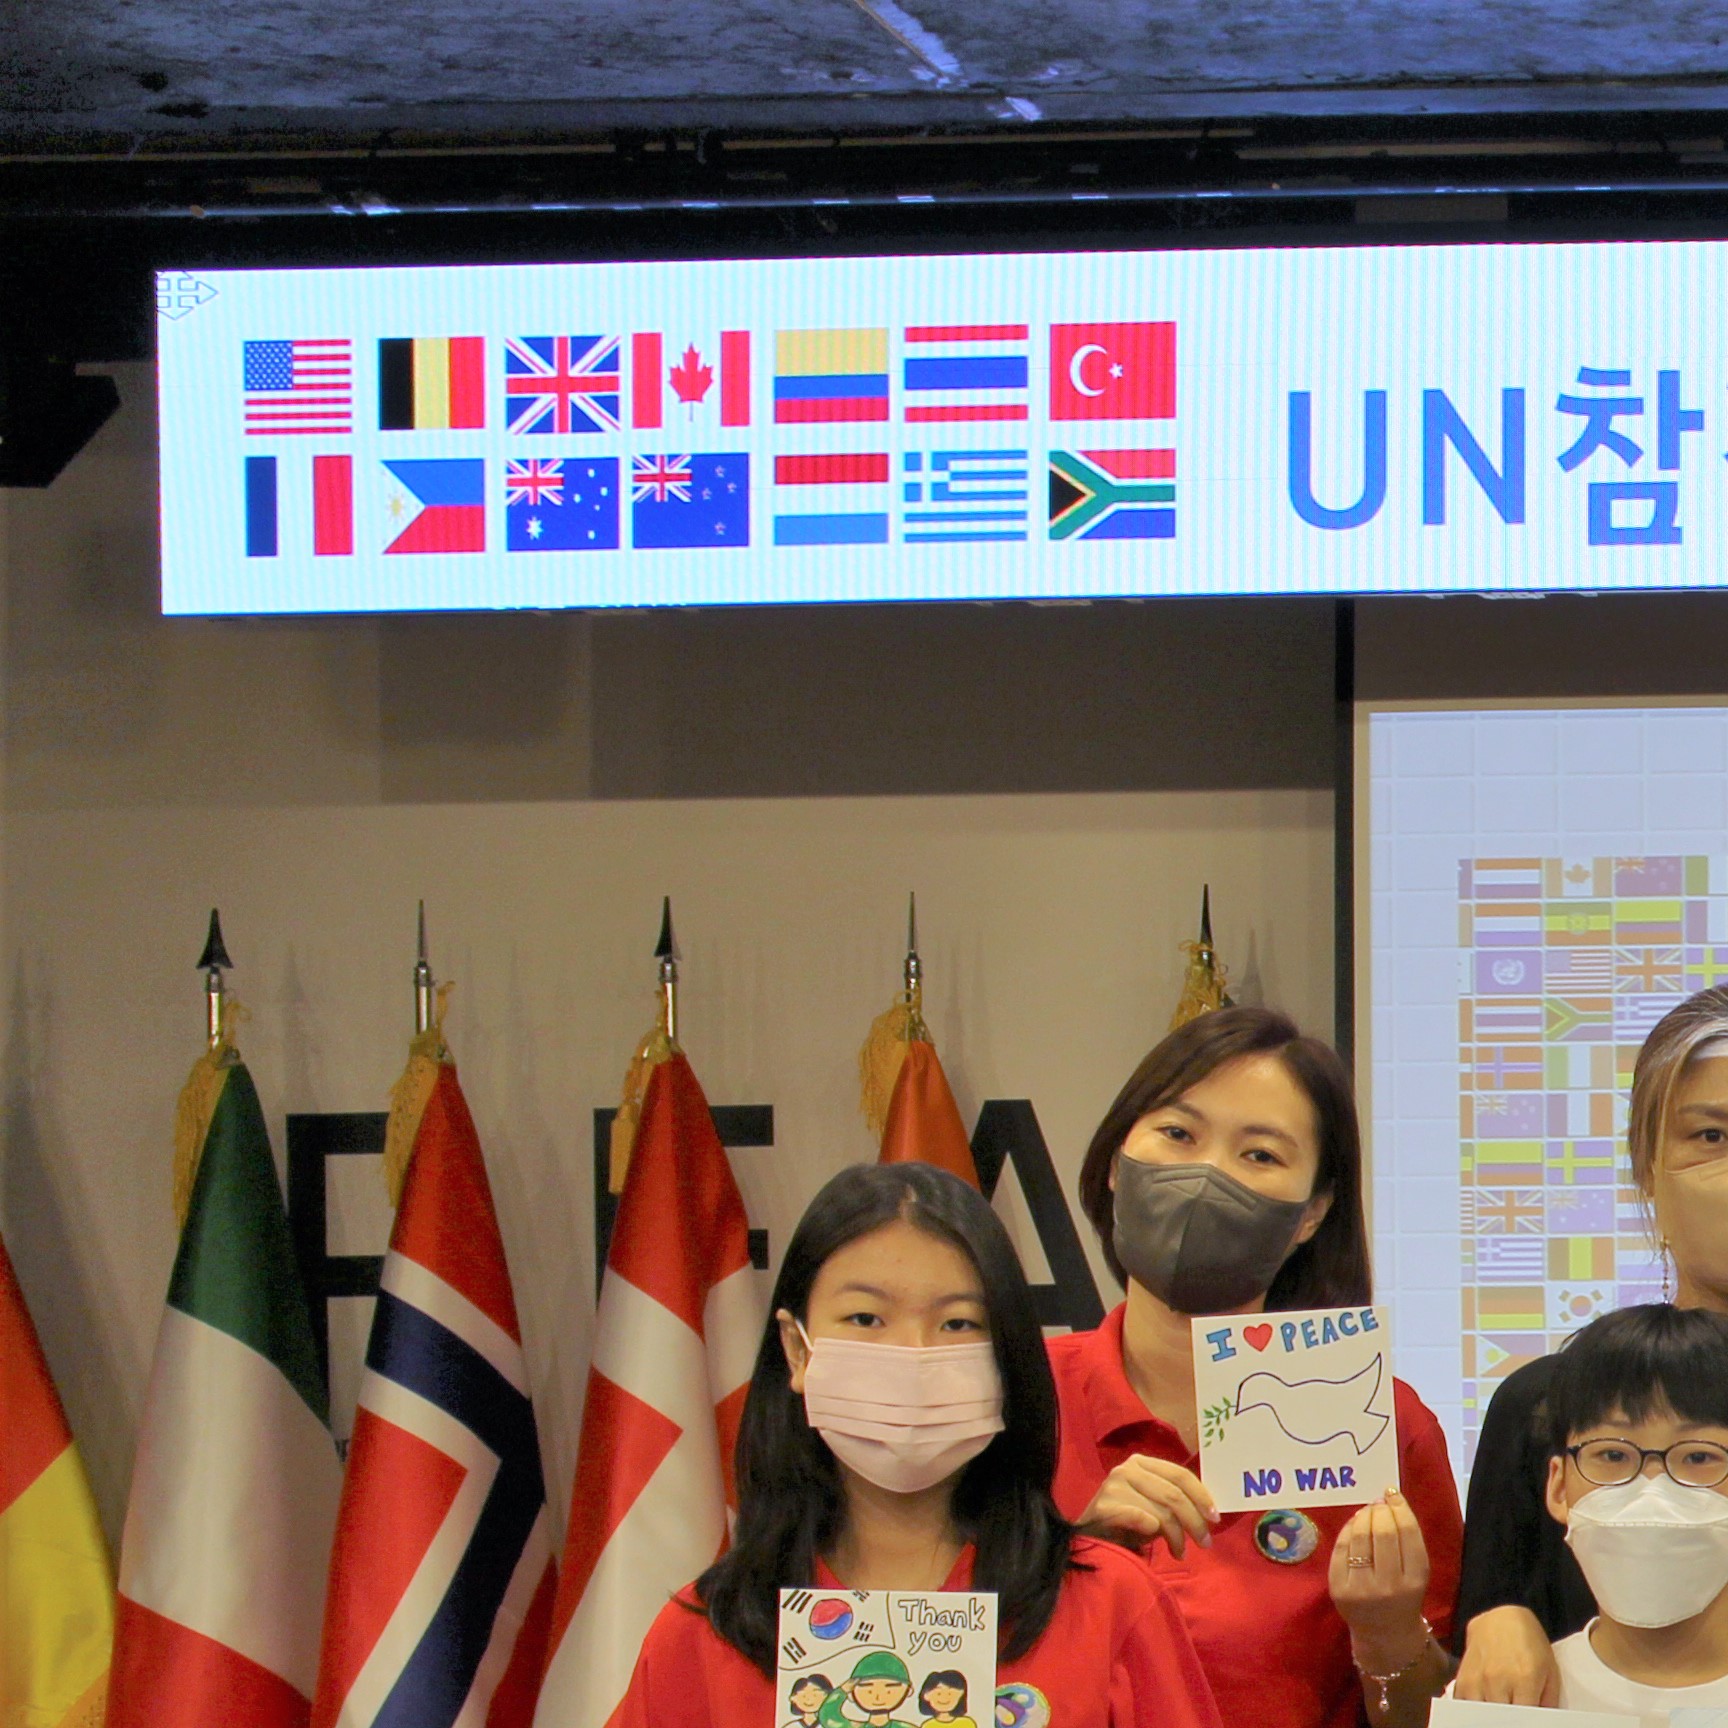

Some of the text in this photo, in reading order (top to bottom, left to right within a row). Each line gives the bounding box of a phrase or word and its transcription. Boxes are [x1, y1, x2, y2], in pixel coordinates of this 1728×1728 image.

[1206, 1307, 1379, 1362] I PEACE
[1243, 1465, 1357, 1498] NO WAR
[898, 1597, 987, 1632] Thank
[906, 1631, 963, 1656] you
